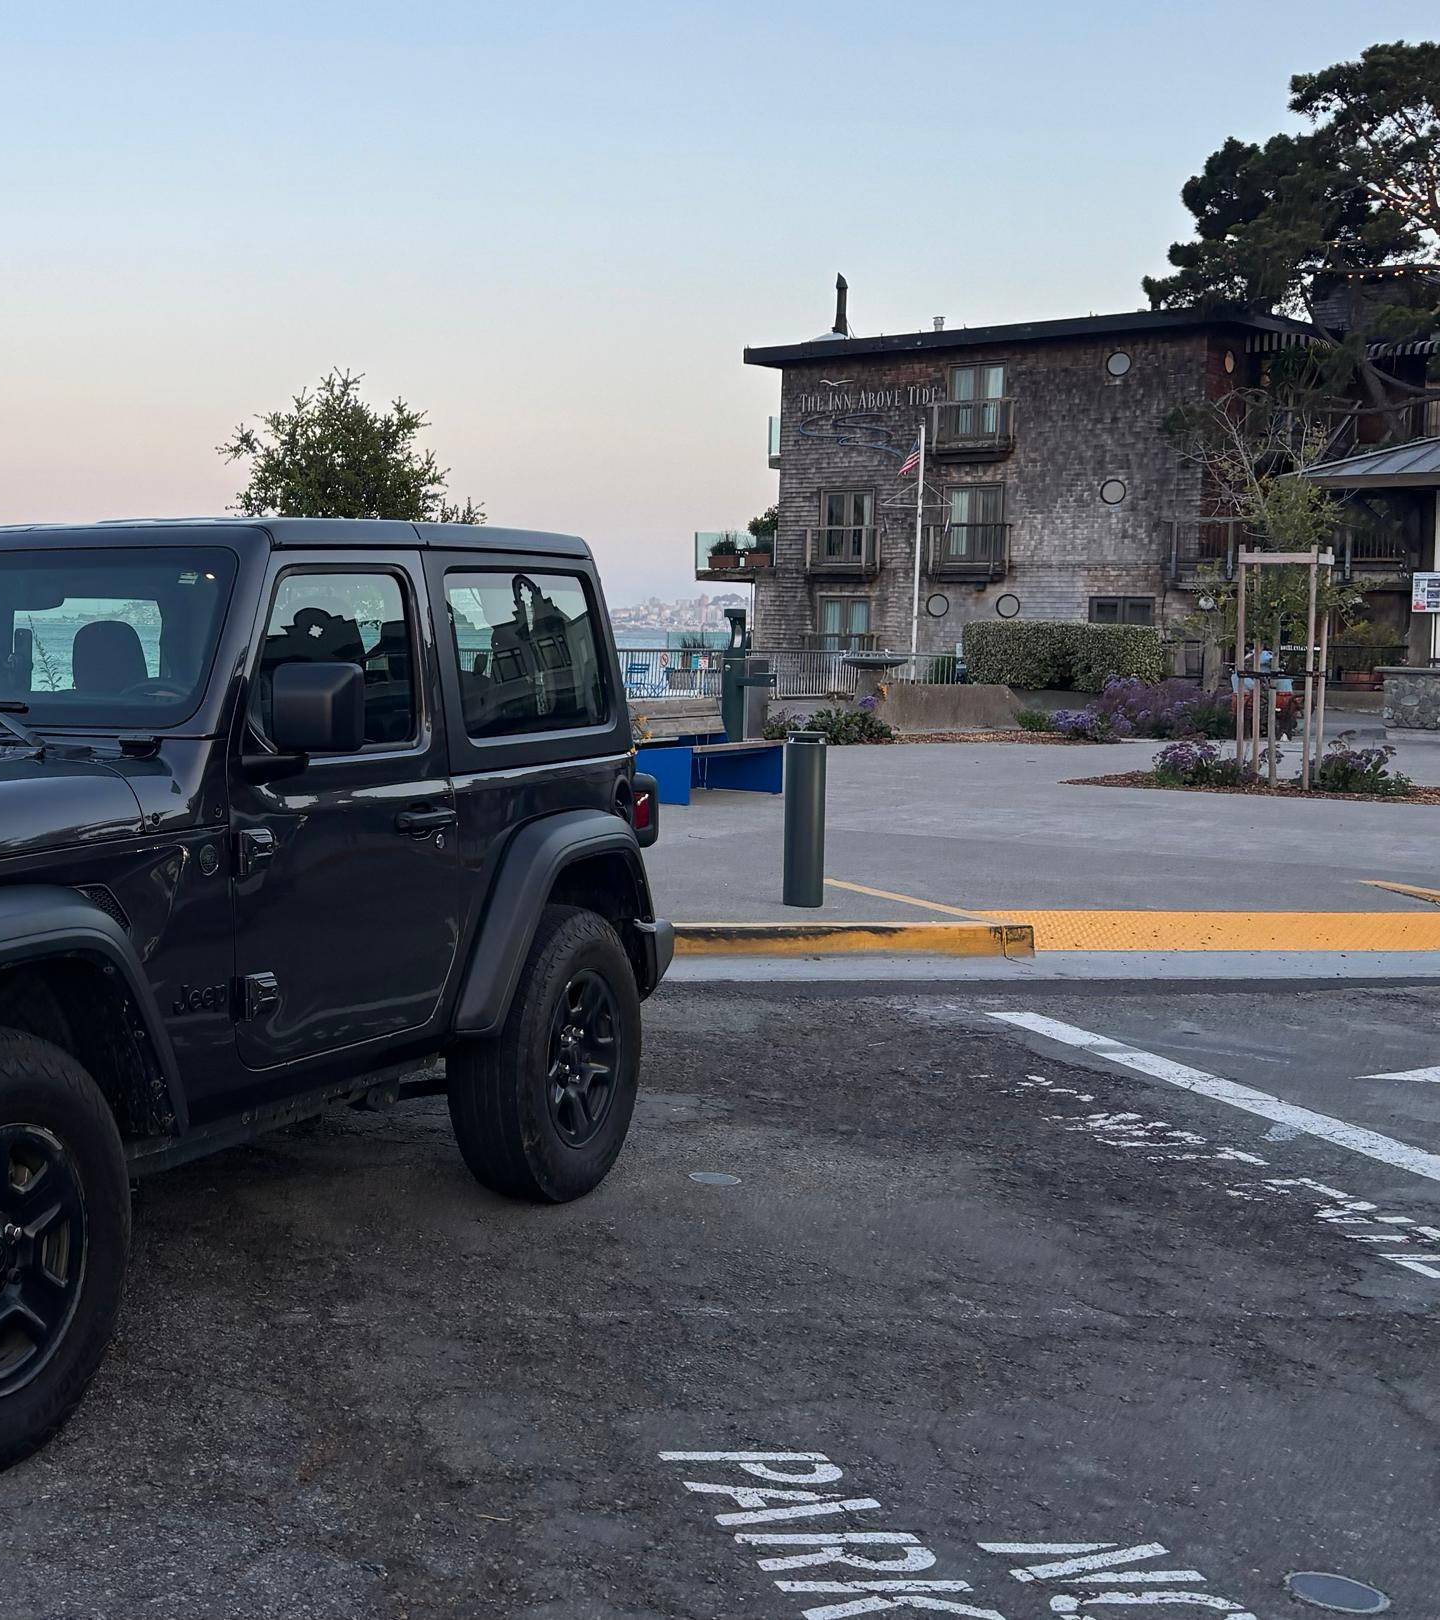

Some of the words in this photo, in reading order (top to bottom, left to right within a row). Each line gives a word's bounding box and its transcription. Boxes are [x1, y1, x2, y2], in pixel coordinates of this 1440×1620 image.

[800, 393, 823, 413] THE
[829, 392, 852, 411] INN
[859, 390, 902, 409] ABOVE
[173, 984, 226, 1016] Jeep
